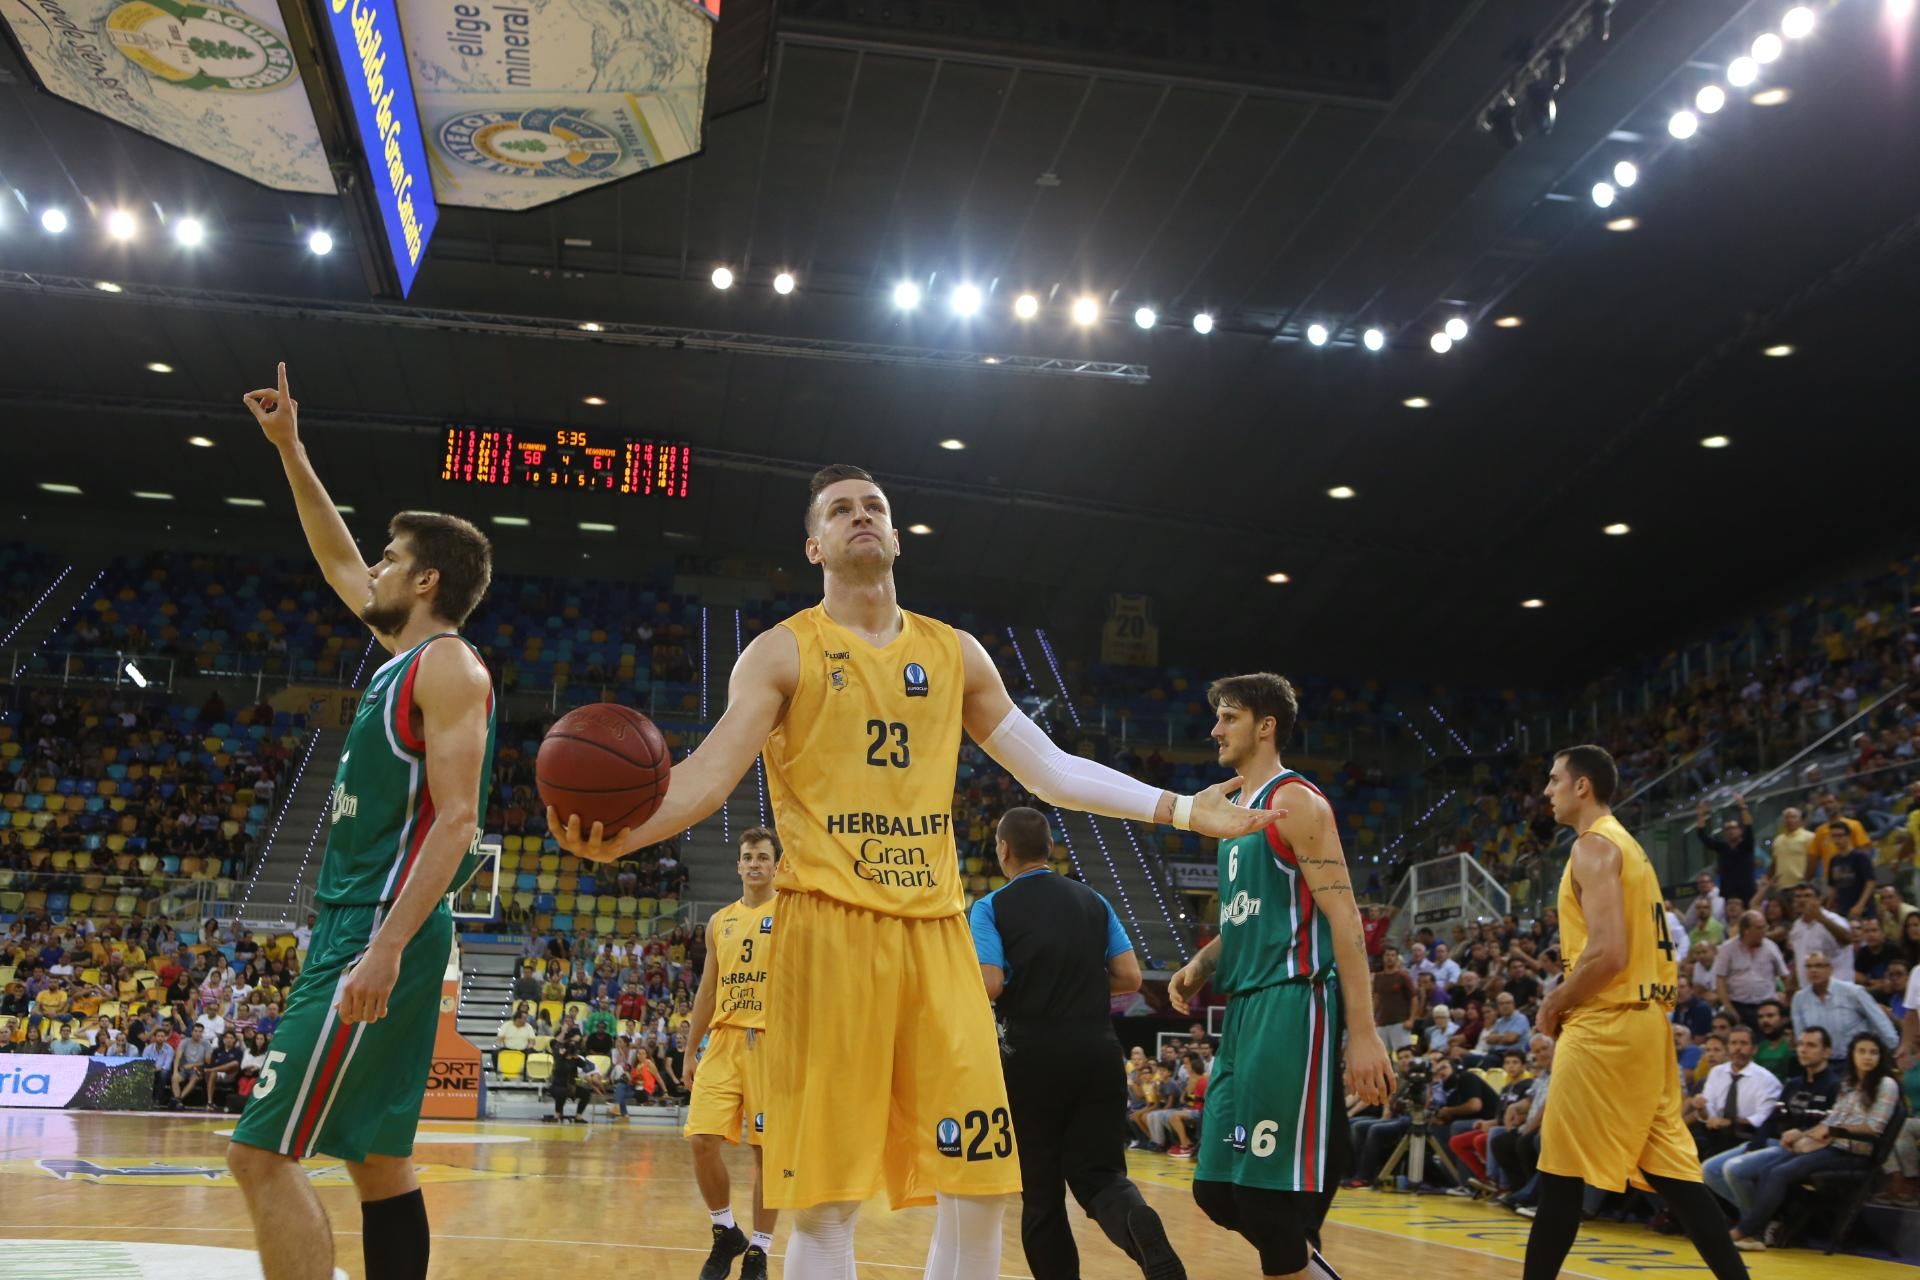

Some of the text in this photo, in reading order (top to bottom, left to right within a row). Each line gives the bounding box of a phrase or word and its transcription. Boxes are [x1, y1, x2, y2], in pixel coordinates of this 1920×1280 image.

[202, 8, 277, 47] AGUA
[447, 4, 491, 57] elige
[493, 5, 531, 87] mineral
[351, 0, 424, 267] Cabildo de Gran Canaria
[524, 451, 541, 465] 58
[557, 431, 586, 446] 5:35
[562, 455, 569, 465] 4
[593, 456, 611, 470] 61
[1117, 615, 1145, 639] 20
[866, 719, 911, 769] 23
[860, 838, 925, 865] Gran
[1228, 845, 1239, 882] 6
[740, 938, 754, 964] 3
[1651, 902, 1674, 962] 4
[253, 1051, 287, 1099] 5
[964, 1107, 1013, 1162] 23
[1250, 1119, 1279, 1158] 6
